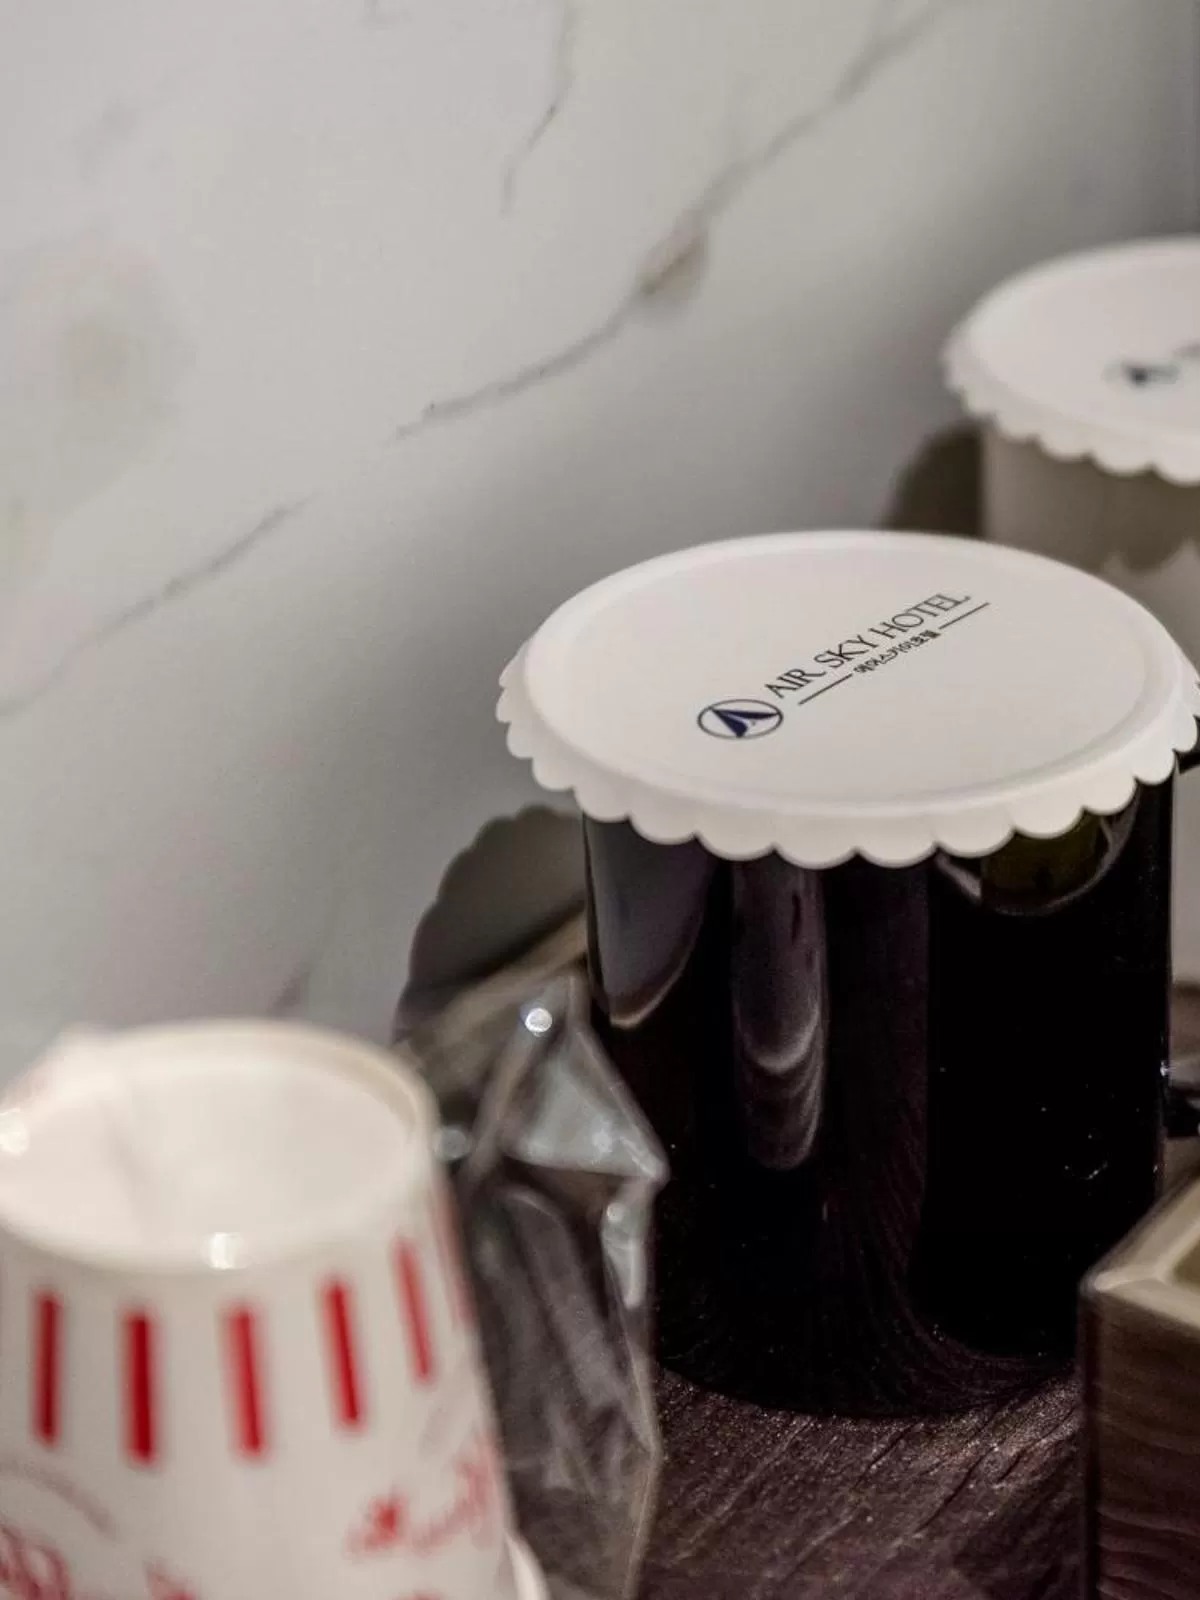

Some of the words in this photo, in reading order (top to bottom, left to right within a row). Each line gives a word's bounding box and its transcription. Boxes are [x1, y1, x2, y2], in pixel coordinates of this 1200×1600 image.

[765, 668, 826, 699] AIR
[814, 635, 878, 669] SKY
[868, 593, 972, 639] HOTEL
